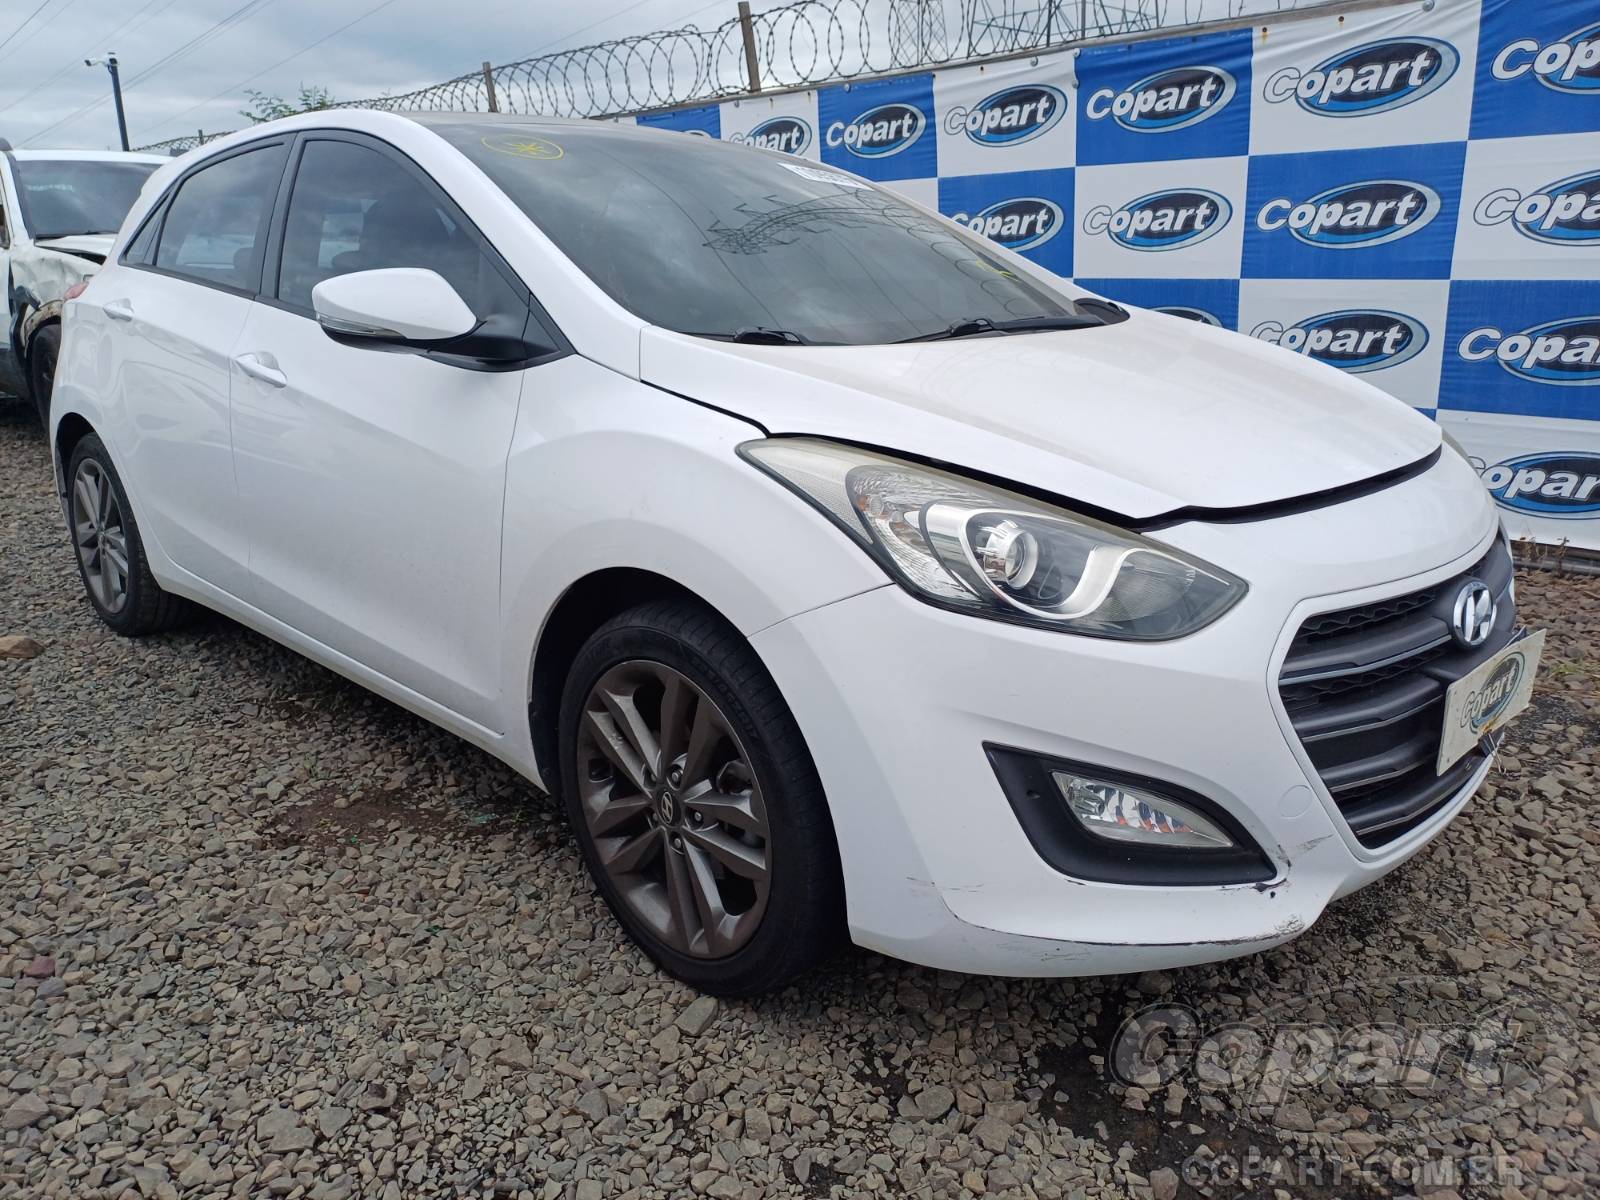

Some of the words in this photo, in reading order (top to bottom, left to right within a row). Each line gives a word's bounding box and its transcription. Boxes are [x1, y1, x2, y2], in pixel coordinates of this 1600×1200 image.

[1263, 48, 1432, 104] Copart
[944, 95, 1051, 136] Copart
[1086, 77, 1217, 121] Copart
[826, 112, 914, 148] Copart
[1083, 200, 1214, 240] Copart
[1257, 190, 1417, 235] Copart
[1249, 321, 1402, 356] Copart
[1458, 327, 1600, 369] Copa
[1468, 456, 1600, 501] opar
[1460, 661, 1518, 728] Copart
